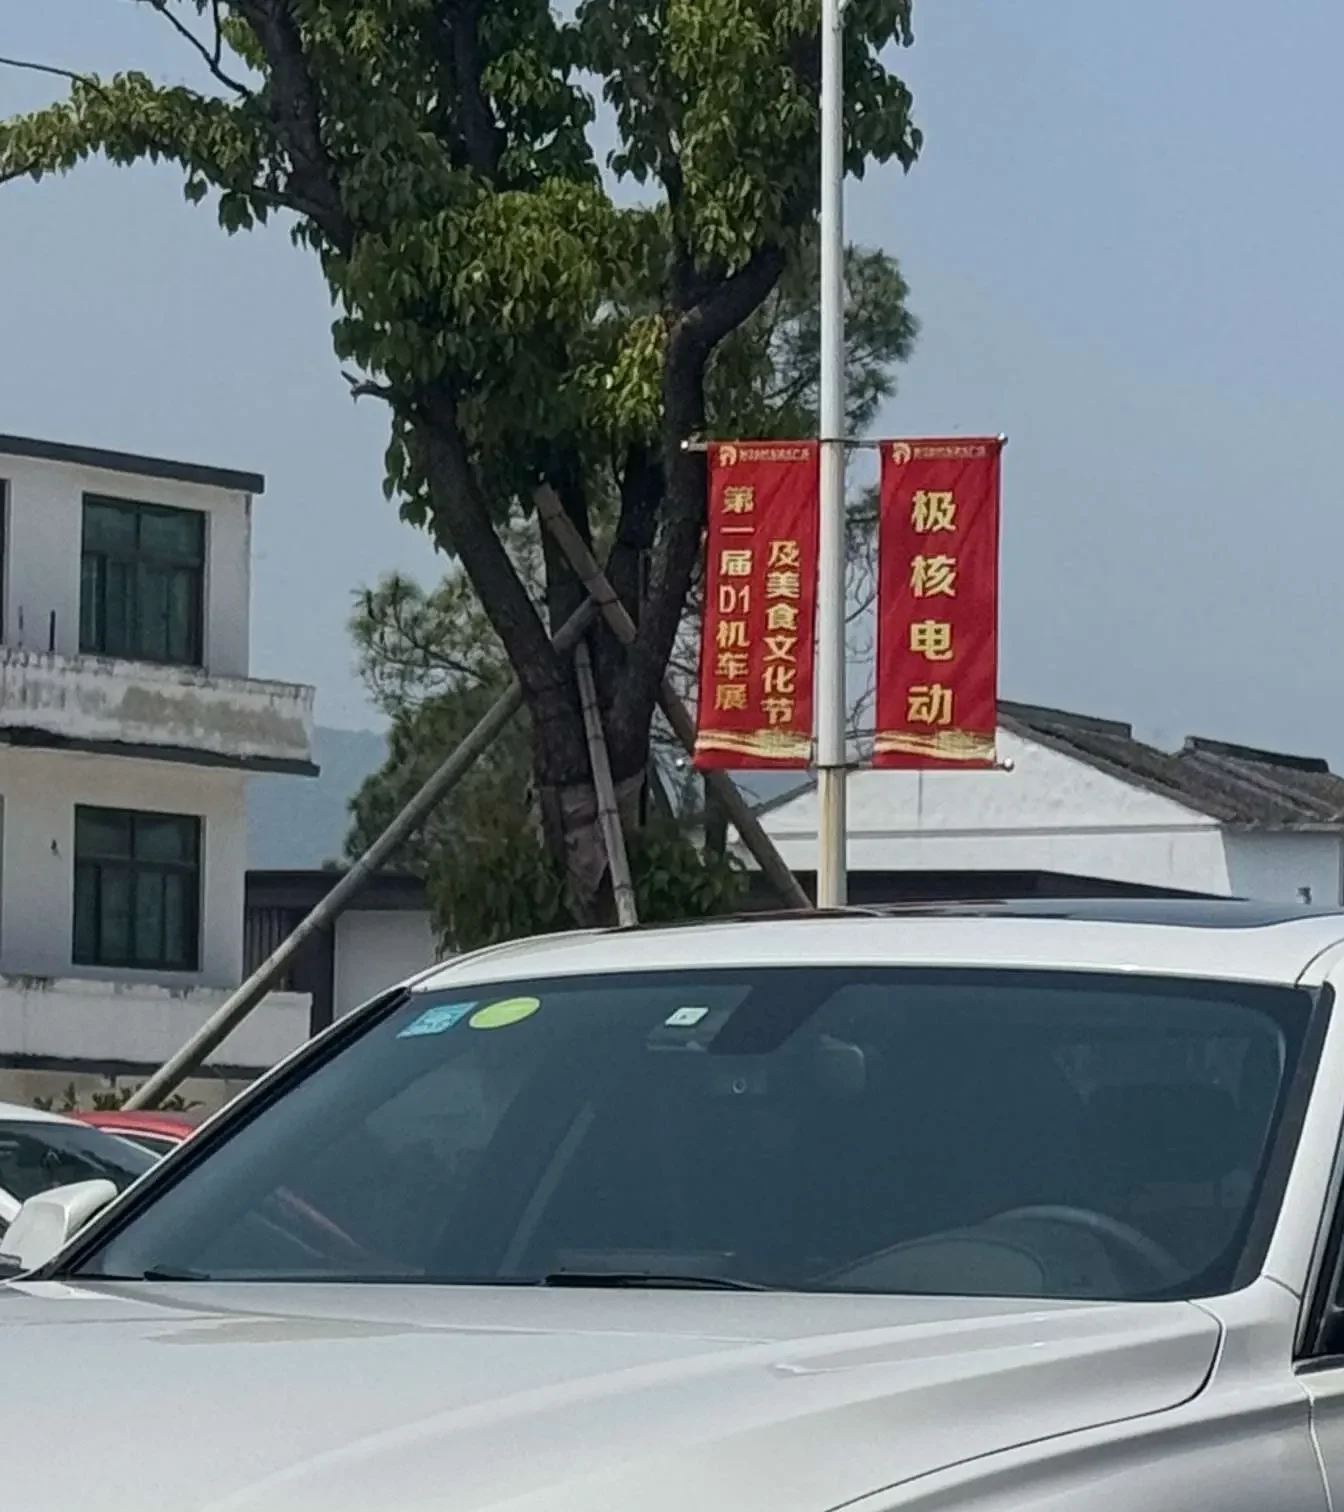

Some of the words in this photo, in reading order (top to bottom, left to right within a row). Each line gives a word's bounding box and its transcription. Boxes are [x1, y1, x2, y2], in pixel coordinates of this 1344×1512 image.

[760, 540, 801, 725] 及美食文化节
[907, 490, 957, 726] 极核电动
